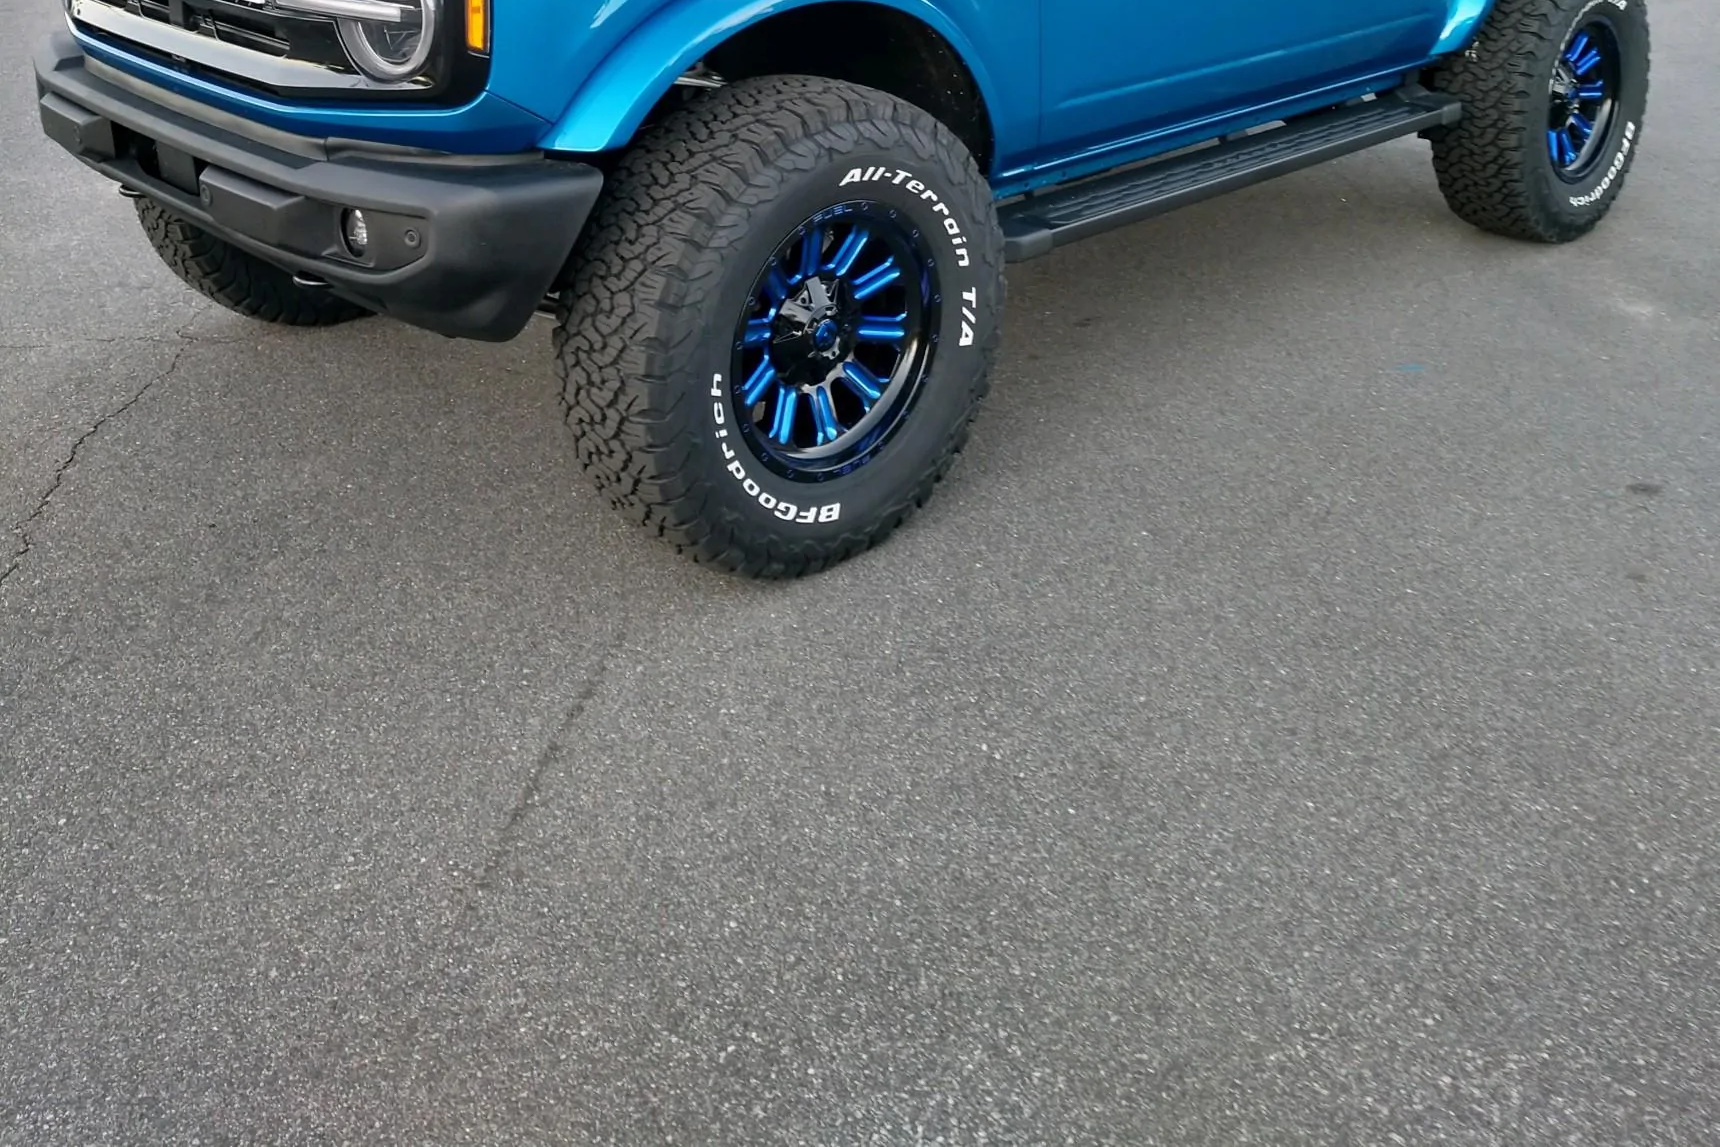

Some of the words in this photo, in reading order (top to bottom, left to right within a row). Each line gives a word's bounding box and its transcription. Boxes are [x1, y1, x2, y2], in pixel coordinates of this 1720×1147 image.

[838, 165, 971, 268] All-Terrain
[957, 286, 977, 348] T/A
[710, 373, 842, 525] BFGoodrich
